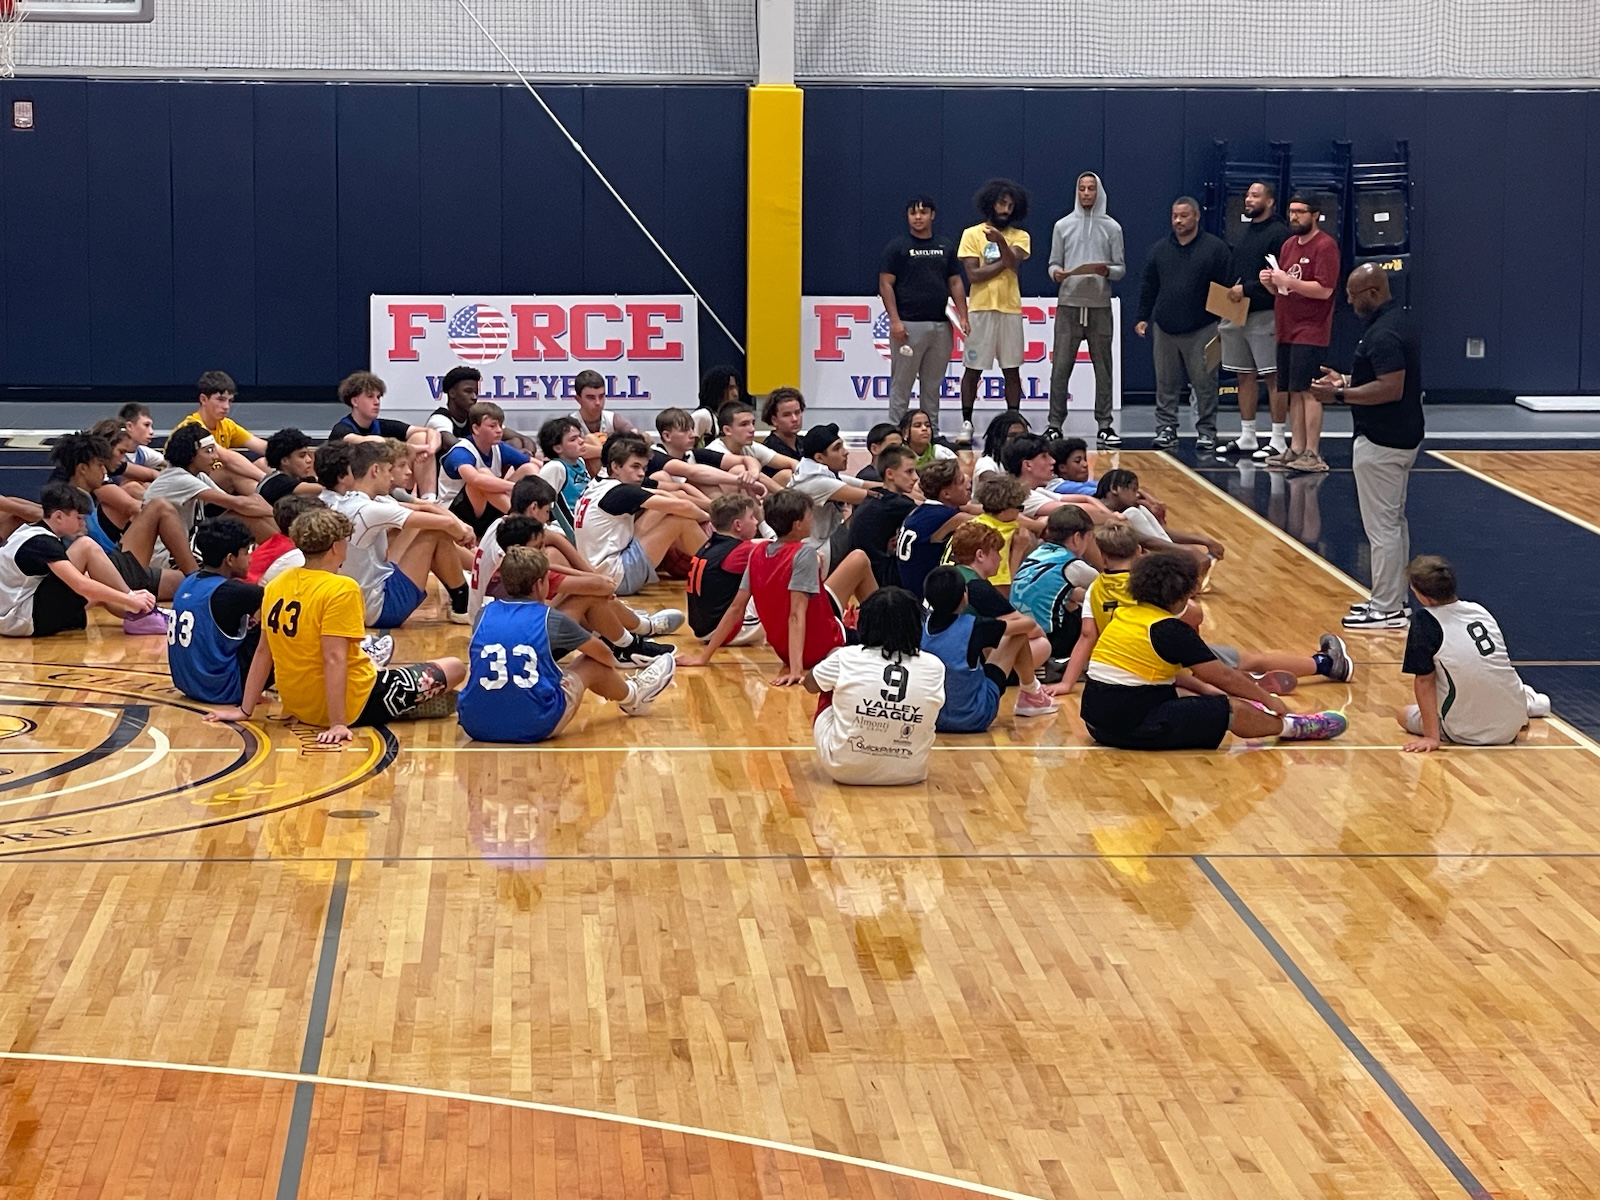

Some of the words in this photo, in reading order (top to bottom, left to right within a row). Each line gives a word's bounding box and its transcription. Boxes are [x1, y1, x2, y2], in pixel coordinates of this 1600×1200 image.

[426, 375, 651, 400] VLEYBLL
[267, 597, 303, 638] 43
[1466, 620, 1496, 657] 8
[479, 643, 540, 691] 33
[881, 664, 909, 702] 9
[855, 705, 924, 724] LEAGUE
[862, 698, 921, 714] VALLEY
